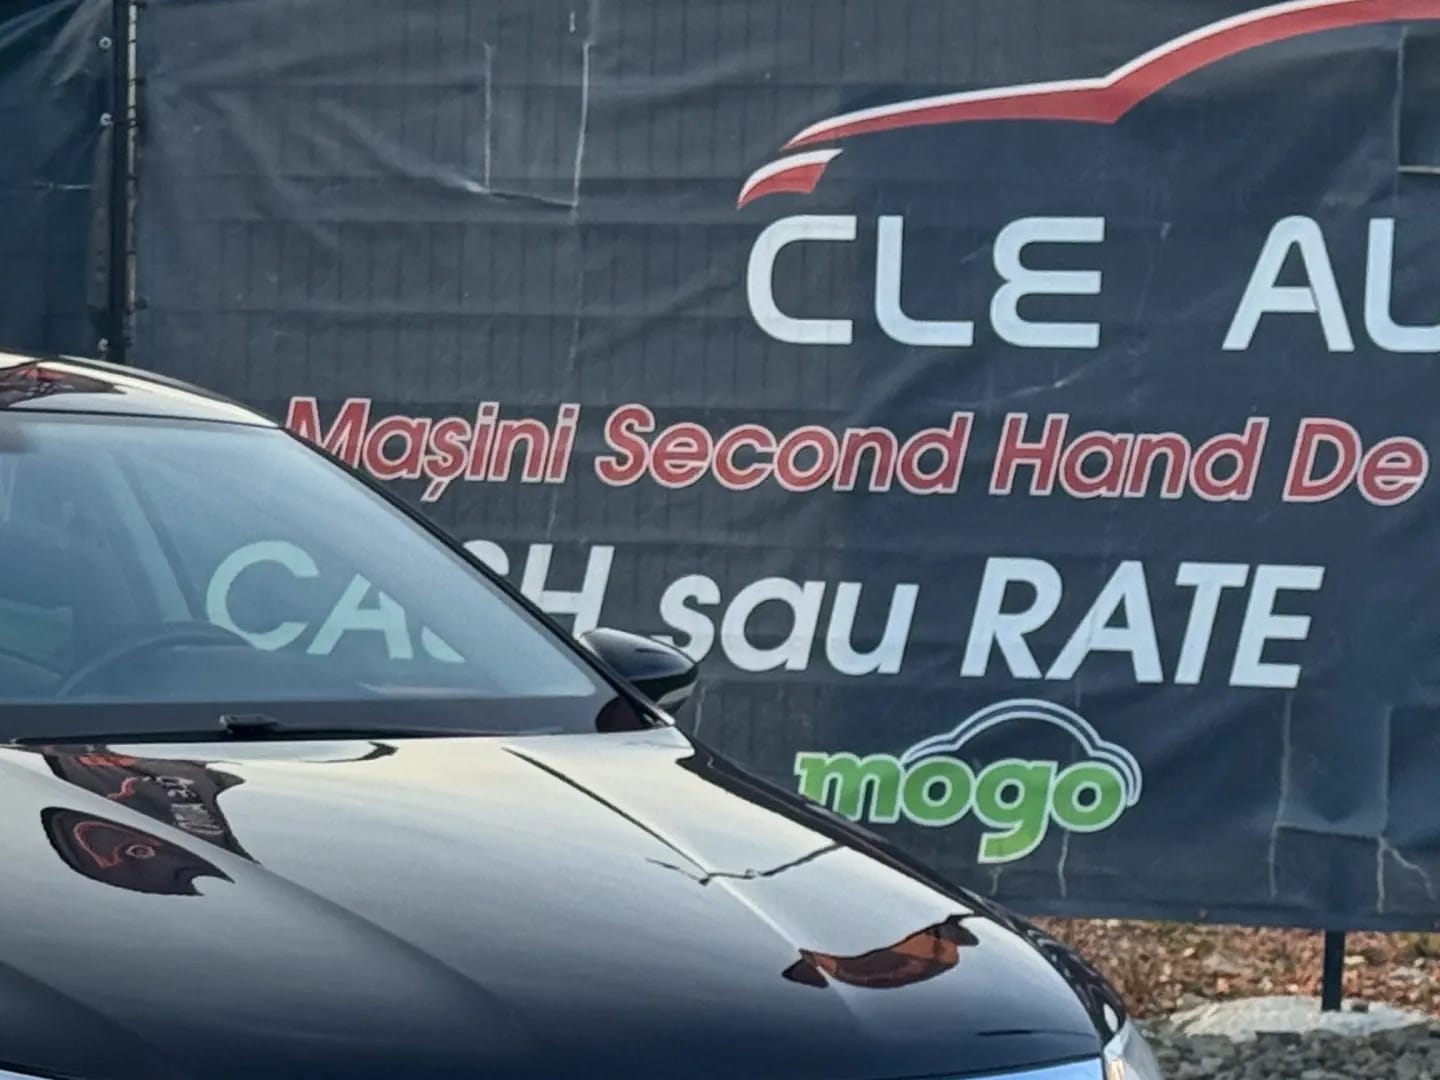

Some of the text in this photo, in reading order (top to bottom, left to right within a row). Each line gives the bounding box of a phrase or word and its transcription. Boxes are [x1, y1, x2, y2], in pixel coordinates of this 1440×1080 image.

[747, 215, 1105, 349] CLE
[594, 403, 974, 496] Second
[988, 412, 1270, 500] Hand
[1282, 416, 1429, 506] De
[651, 573, 920, 676] sau
[960, 556, 1325, 689] RATE
[793, 751, 1127, 864] mogo
